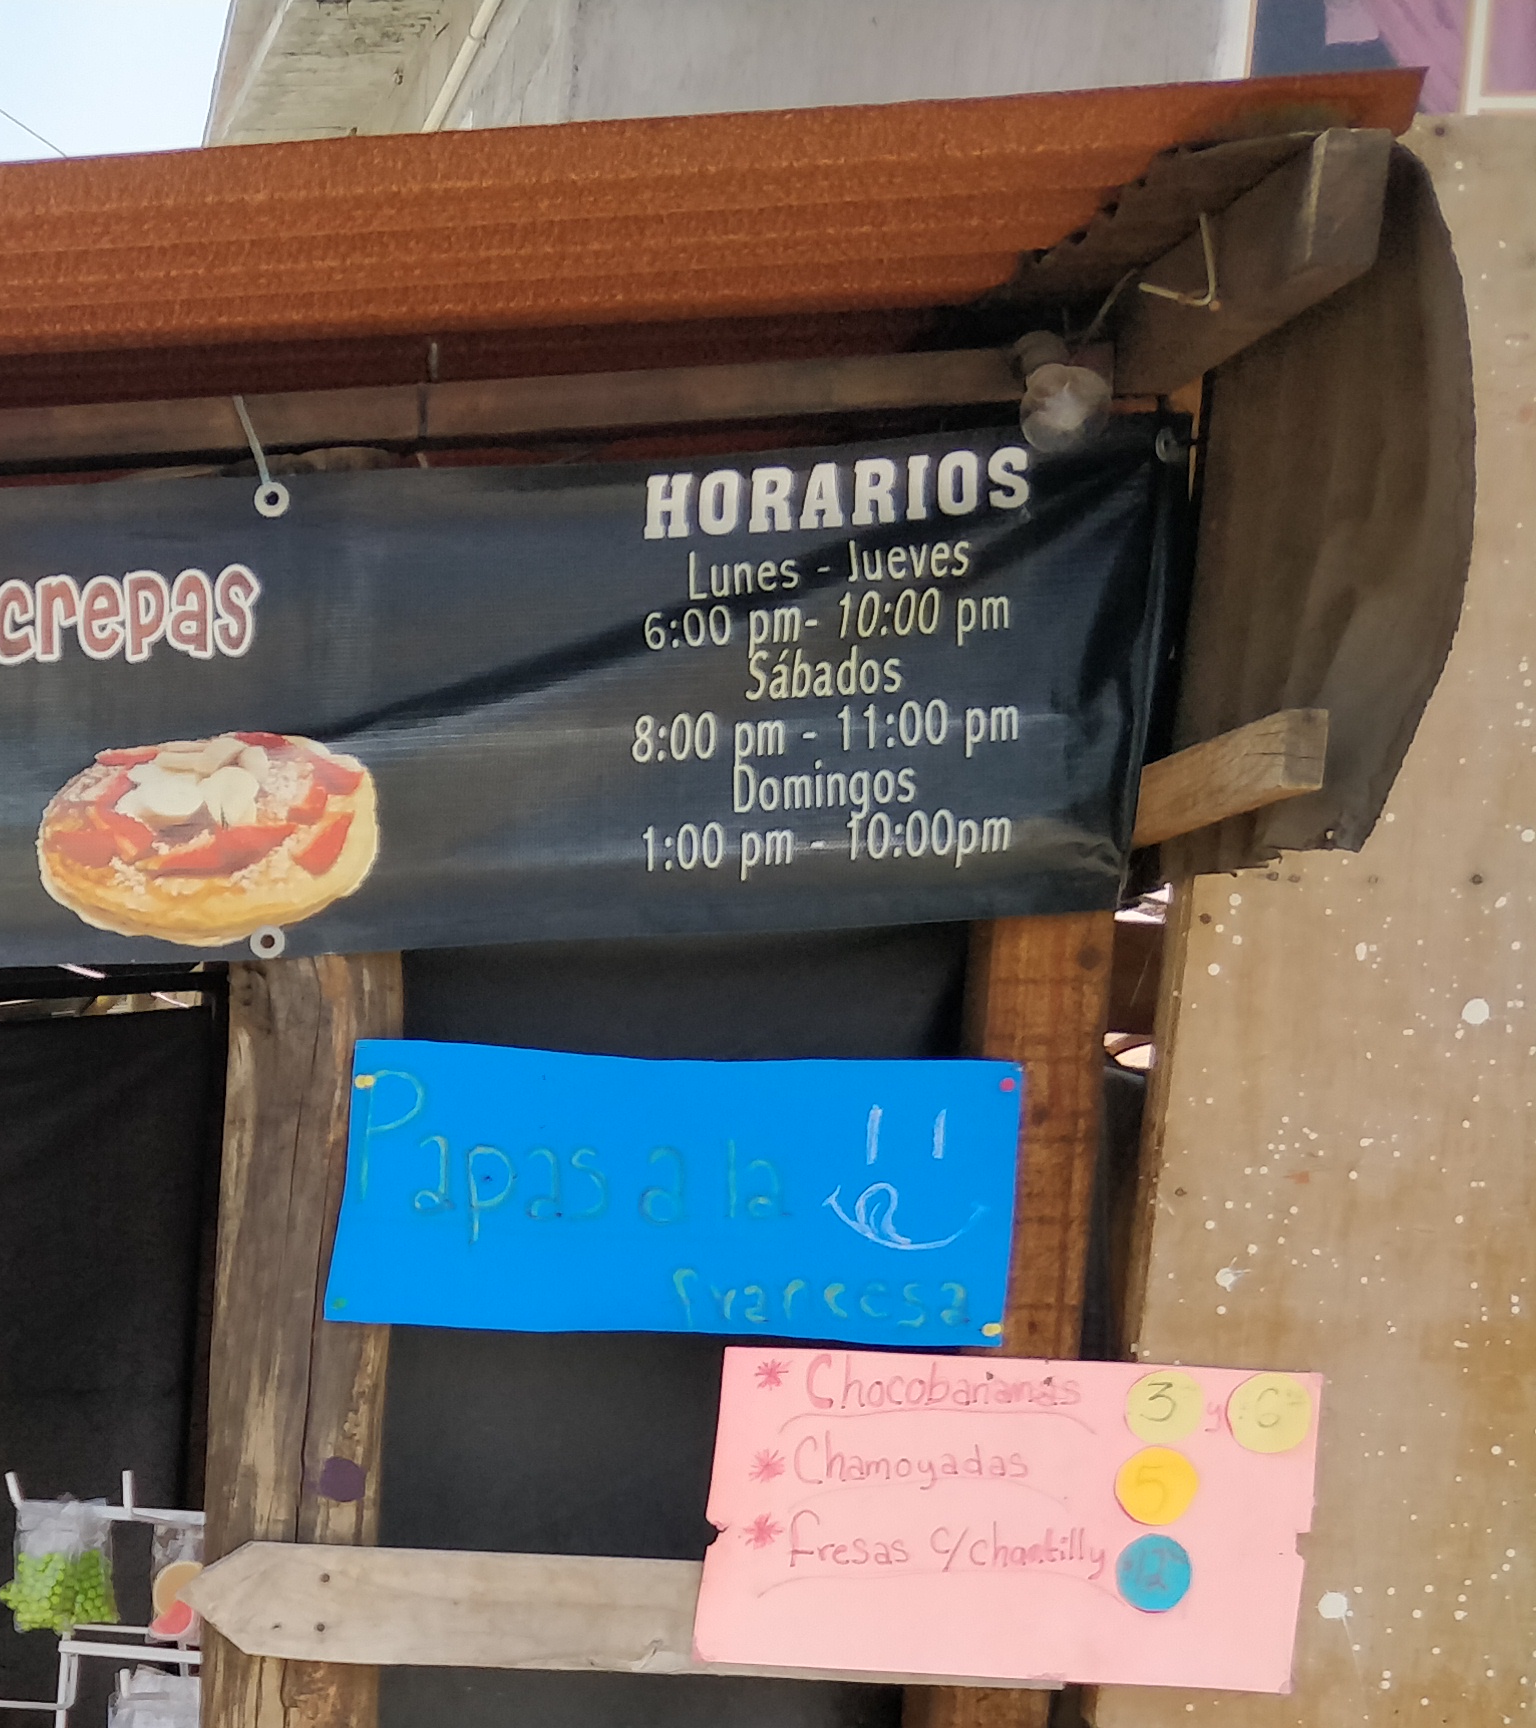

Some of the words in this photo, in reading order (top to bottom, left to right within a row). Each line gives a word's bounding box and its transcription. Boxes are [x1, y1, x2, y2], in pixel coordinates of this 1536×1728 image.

[643, 446, 1030, 540] HORARIOS
[687, 551, 800, 600] Lunes
[847, 538, 971, 582] Jueves
[643, 605, 732, 651] 6:00
[837, 586, 942, 640] 10:00
[956, 594, 1011, 647] pm
[744, 645, 904, 701] Sábados
[630, 711, 719, 763] 8:00
[733, 718, 786, 770] pm
[837, 698, 949, 751] 11:00
[964, 702, 1020, 759] pm
[732, 759, 918, 817] Domingos
[642, 821, 725, 872] 1:00
[740, 826, 795, 883] pm
[360, 1069, 607, 1246] Papas
[639, 1145, 685, 1225] a
[726, 1138, 784, 1219] la
[794, 1430, 1029, 1491] Chamoyadas
